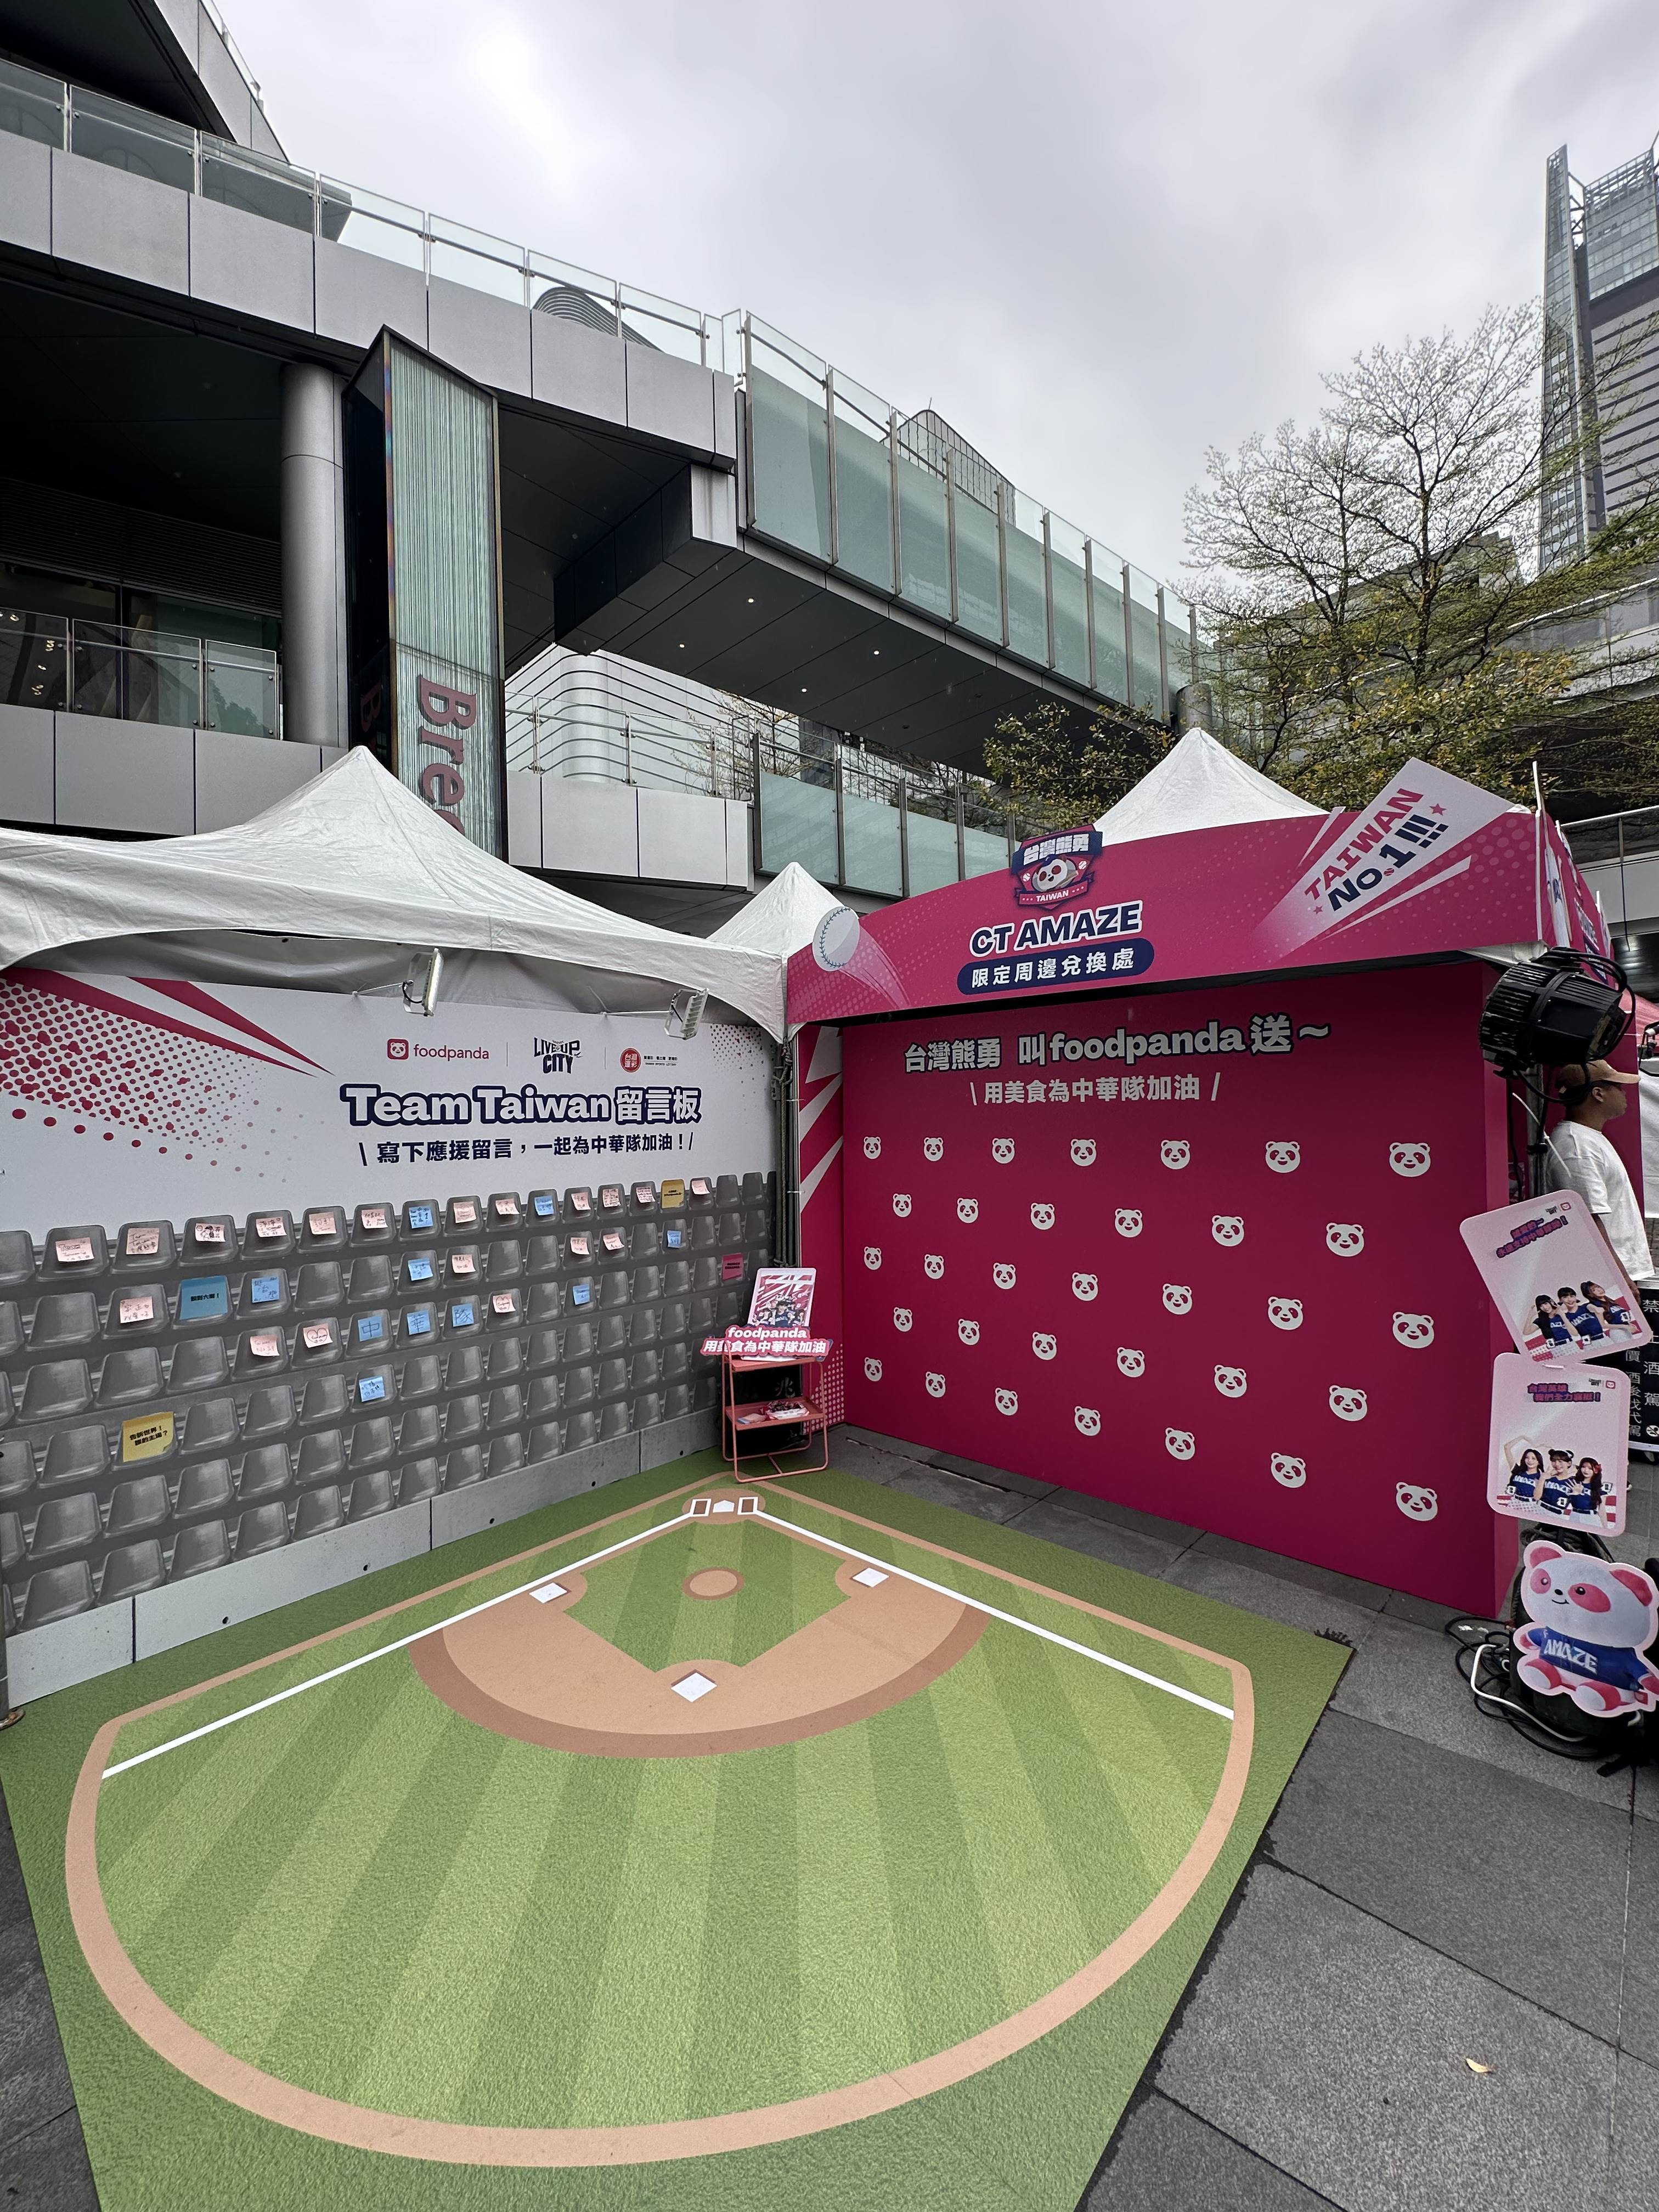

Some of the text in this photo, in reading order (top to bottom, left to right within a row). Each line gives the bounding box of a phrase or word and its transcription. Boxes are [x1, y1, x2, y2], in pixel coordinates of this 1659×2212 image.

[417, 674, 477, 836] Bre
[1023, 833, 1090, 866] 台灣熊勇
[1304, 788, 1424, 901] TAIWAN
[1036, 889, 1069, 902] TAIWAN
[970, 901, 1142, 956] CT AMAZE
[971, 947, 1135, 988] 限定周邊兌換處
[413, 1043, 490, 1062] foodpanda
[542, 1052, 574, 1075] CITY
[904, 1037, 1001, 1073] 台灣熊勇
[341, 1084, 701, 1125] Team Taiwan 留言板
[984, 1073, 1200, 1104] 用美食為中華隊加油
[362, 1321, 380, 1338] 中
[727, 1327, 808, 1339] foodpanda
[1543, 1639, 1598, 1675] AMAZE
